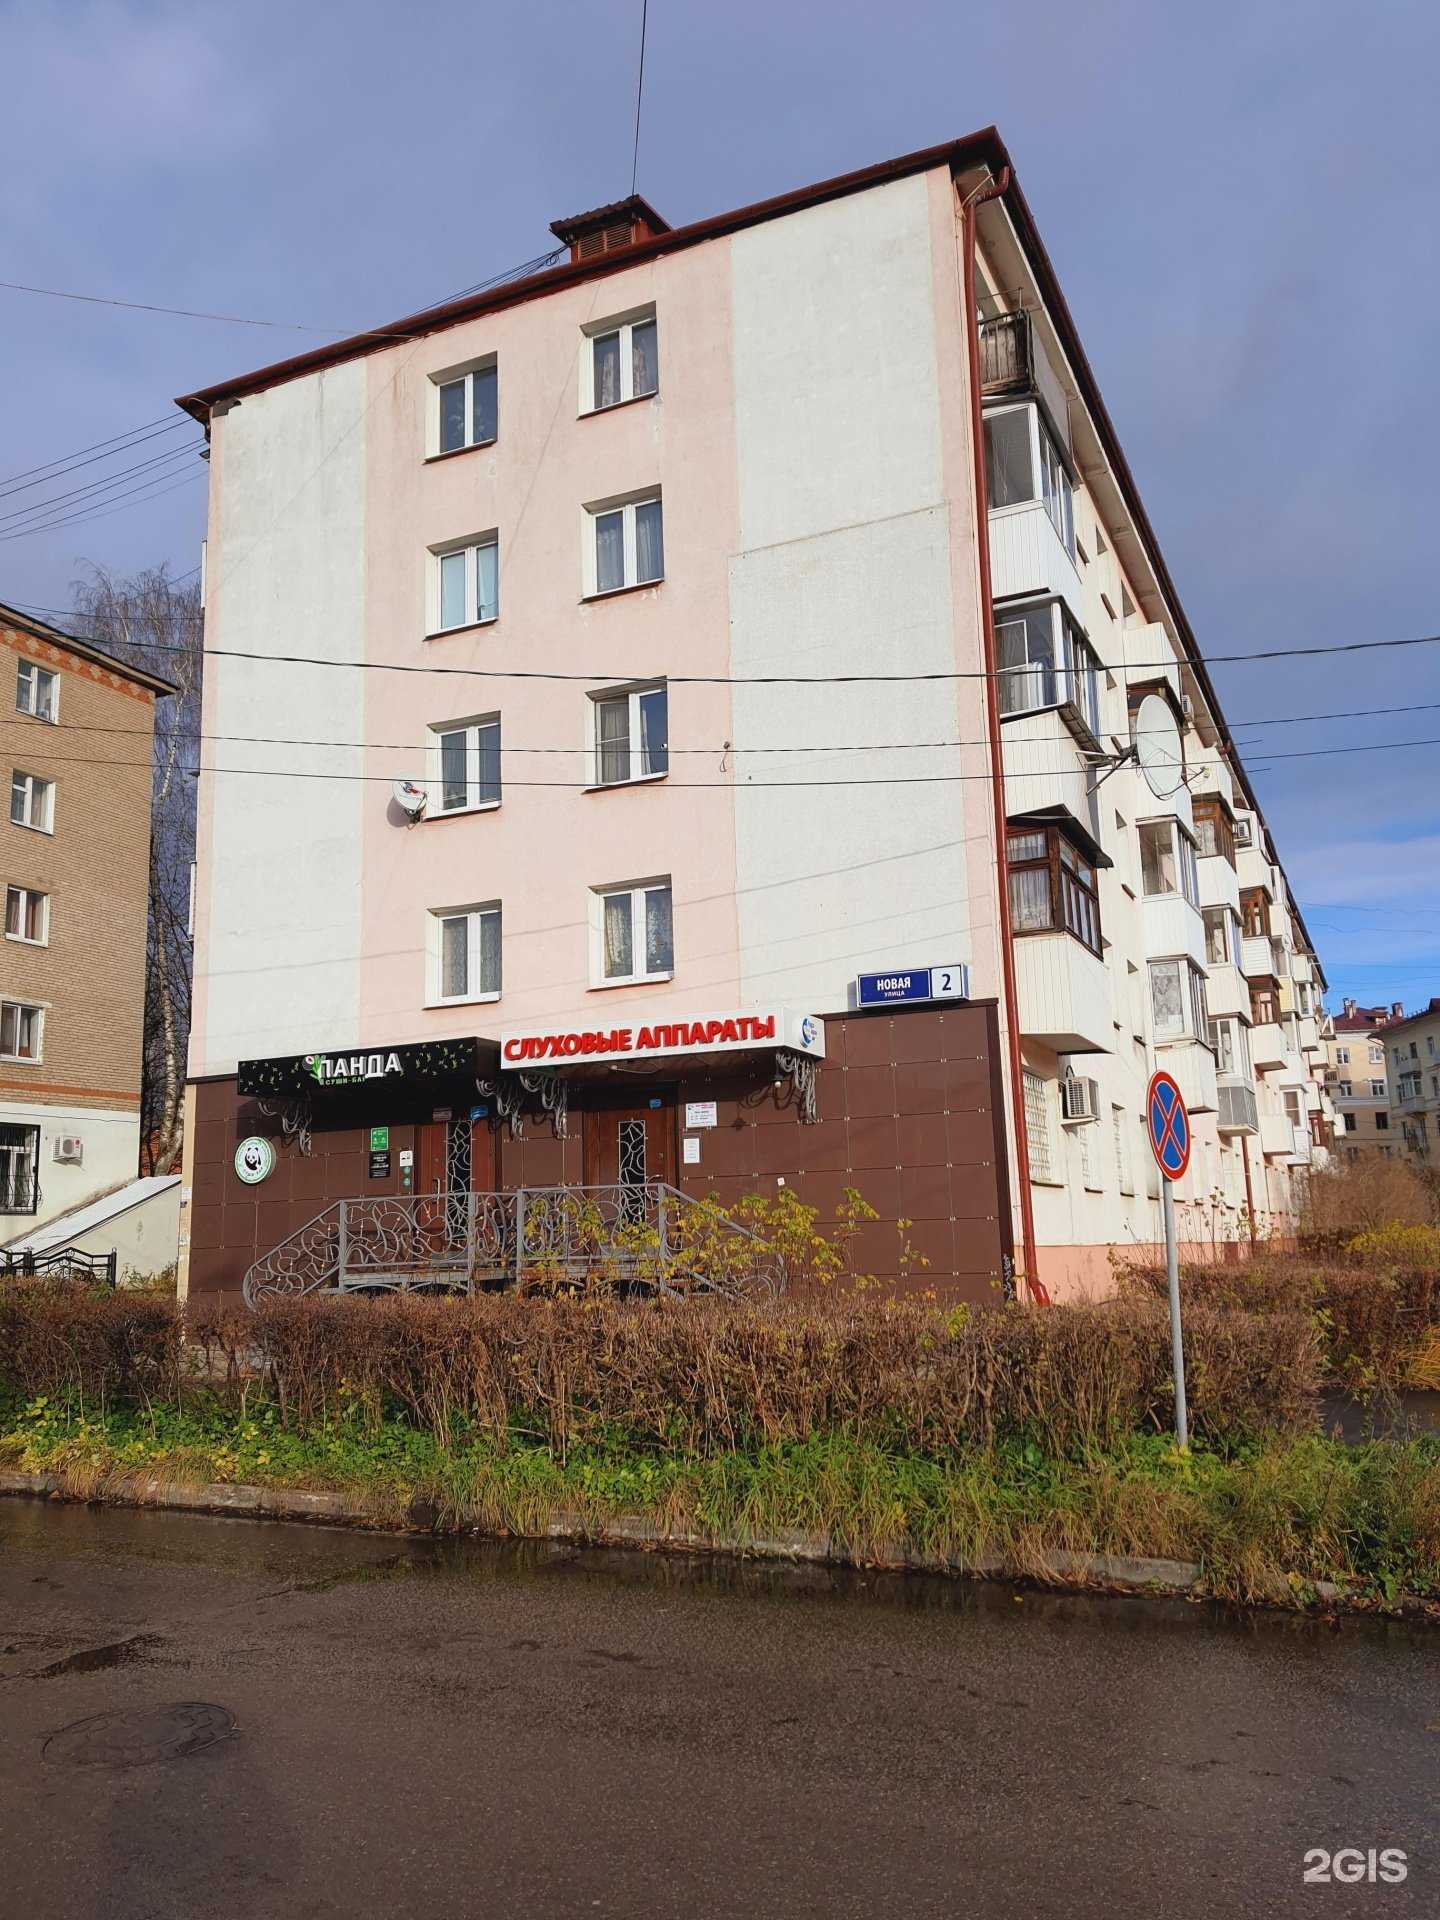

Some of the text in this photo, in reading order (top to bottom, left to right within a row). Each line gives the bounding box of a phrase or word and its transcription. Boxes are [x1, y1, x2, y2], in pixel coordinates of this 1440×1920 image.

[877, 974, 952, 991] НОВАЯ 2
[504, 1028, 633, 1061] СЛУХОВЫЕ
[635, 1015, 775, 1050] АППАРАТЫ
[319, 1053, 403, 1079] ПАНДА
